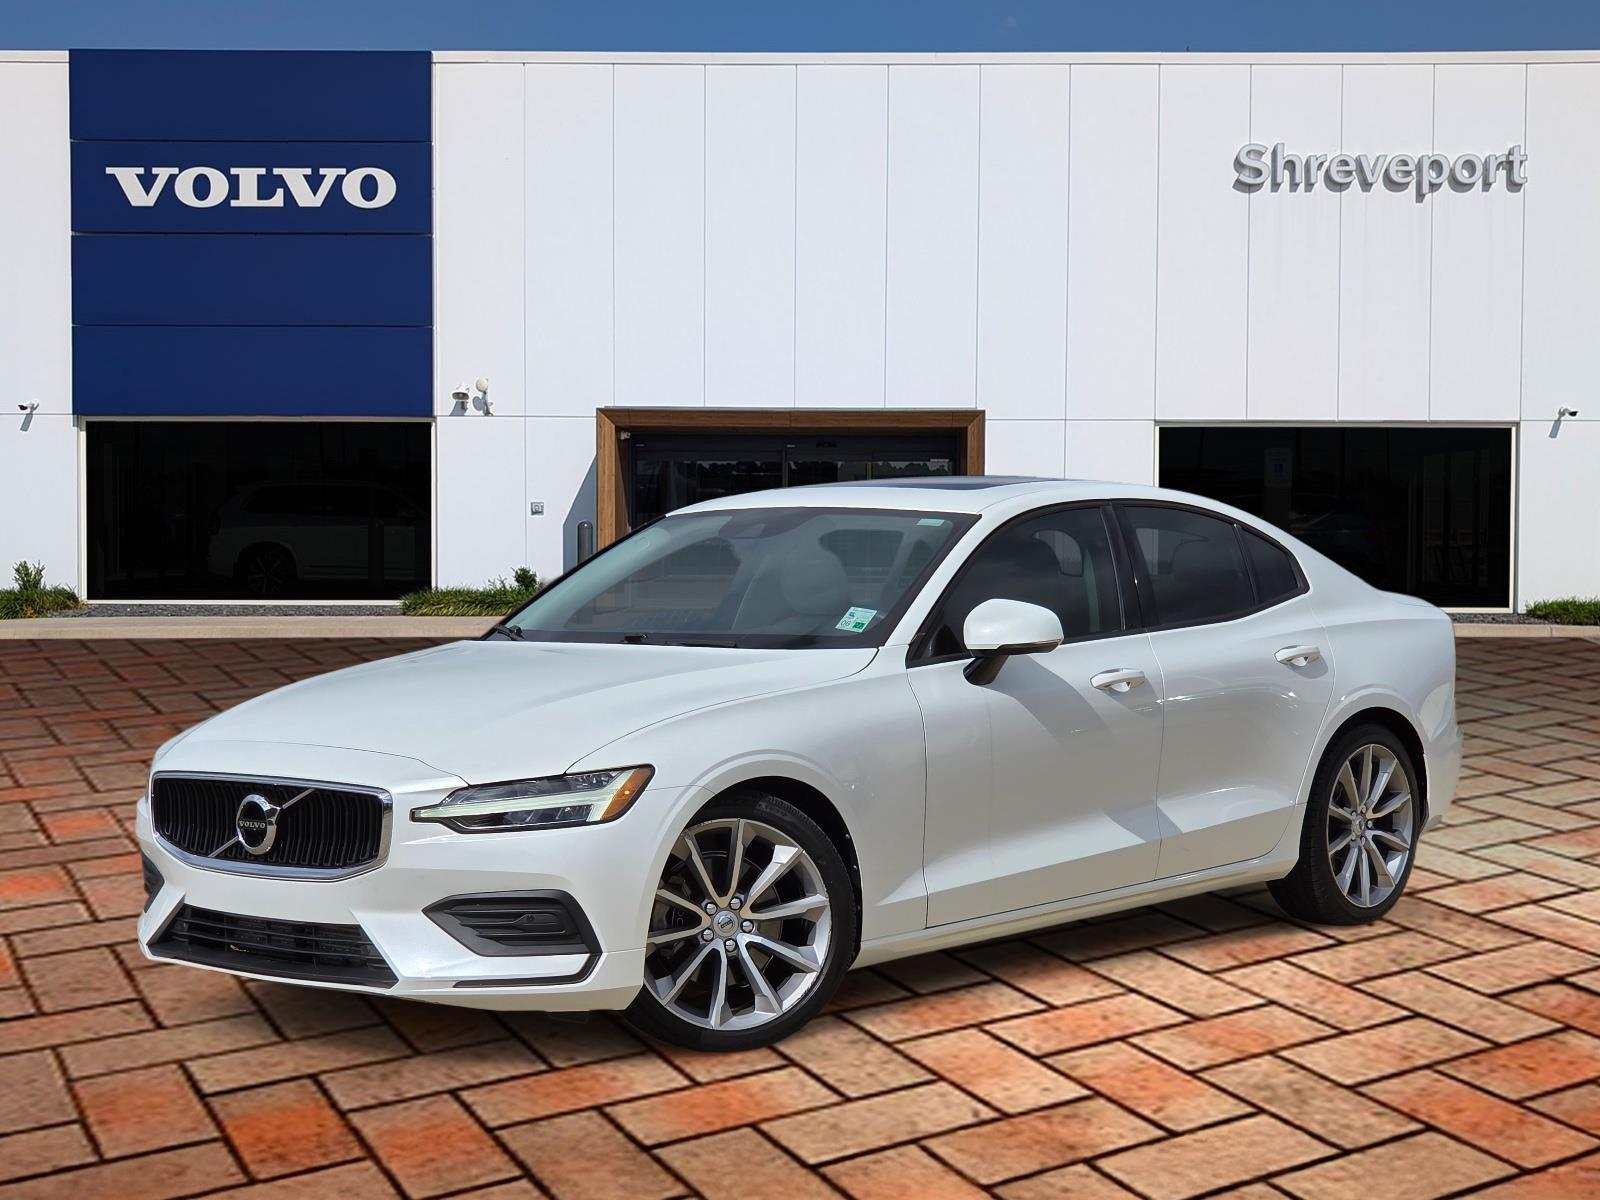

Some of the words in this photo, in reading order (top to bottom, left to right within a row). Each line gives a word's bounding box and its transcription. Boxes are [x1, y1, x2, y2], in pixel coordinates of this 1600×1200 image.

[106, 167, 397, 209] VOLVO
[1233, 143, 1528, 203] Shreveport
[239, 820, 266, 829] VOLVO
